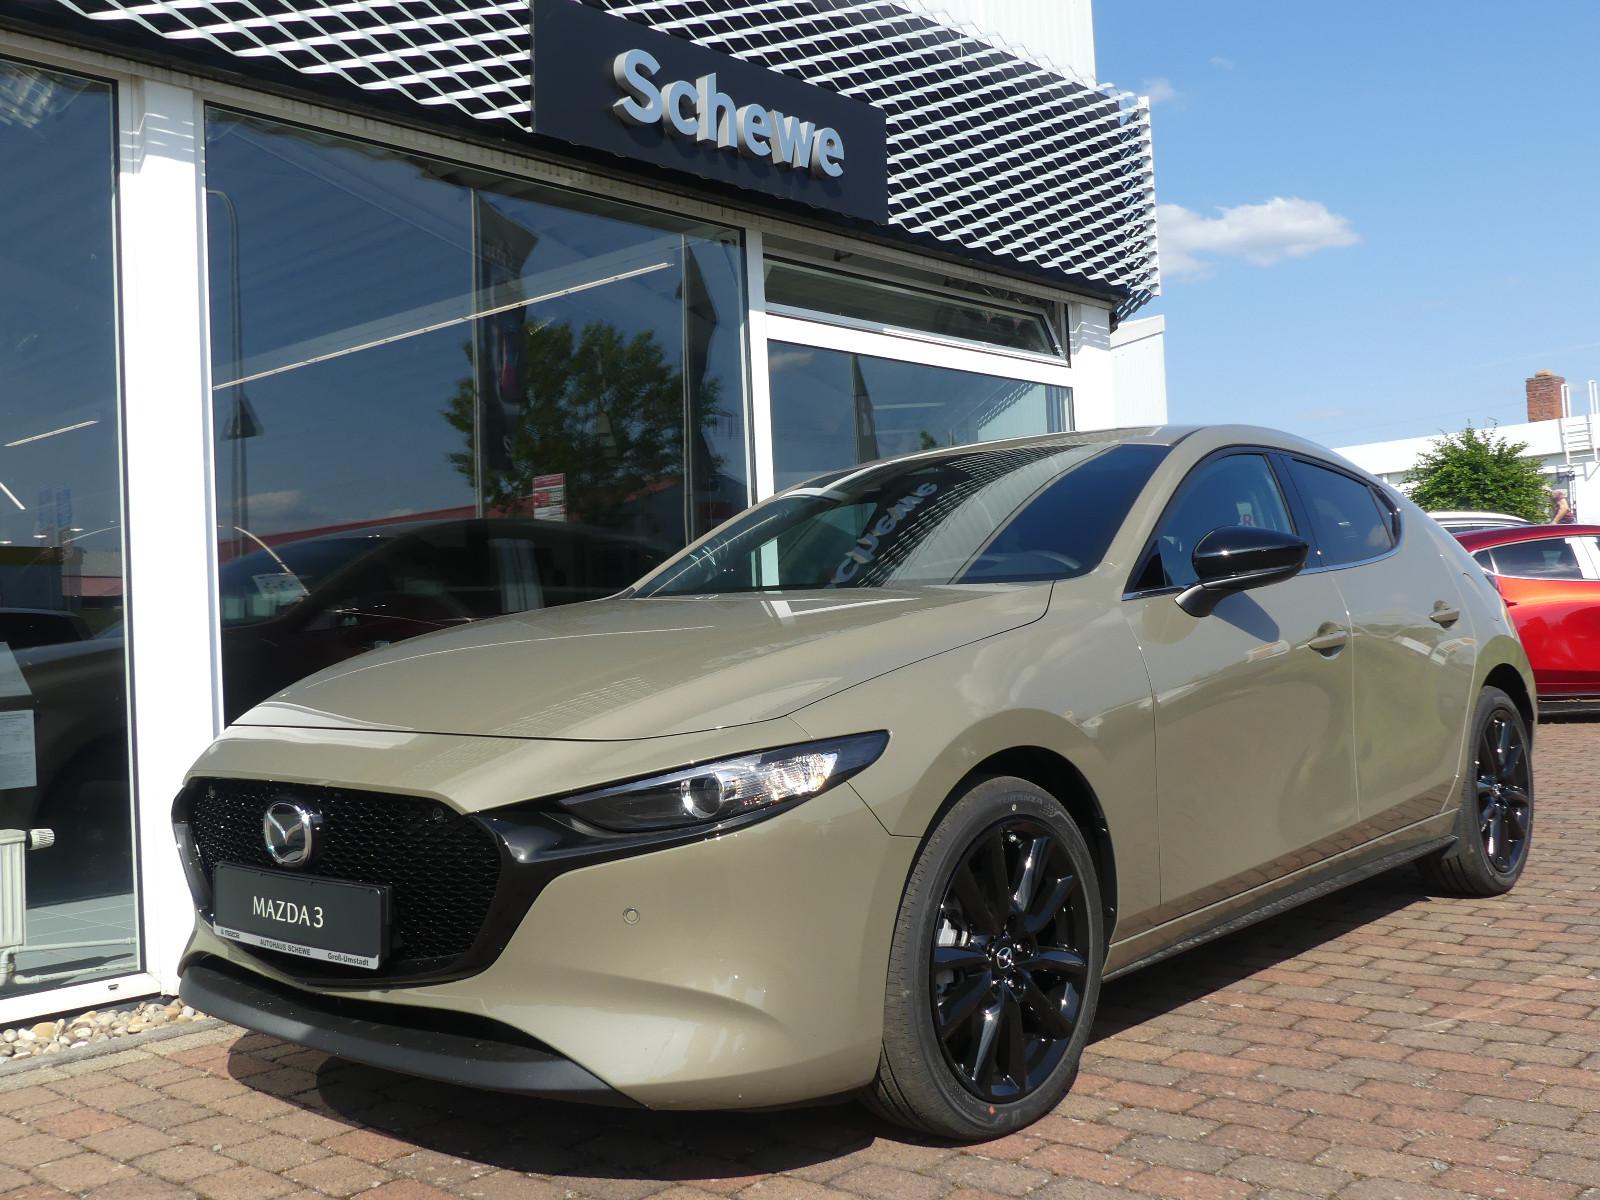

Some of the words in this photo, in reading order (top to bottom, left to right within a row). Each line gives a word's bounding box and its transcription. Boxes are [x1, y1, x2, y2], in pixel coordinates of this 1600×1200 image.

[613, 49, 844, 177] Schewe
[253, 896, 310, 926] MAZDA
[313, 906, 324, 928] 3
[260, 938, 287, 951] AUTOHAUS
[287, 944, 311, 956] SCHEWE
[327, 952, 369, 967] Groß-Umstadt
